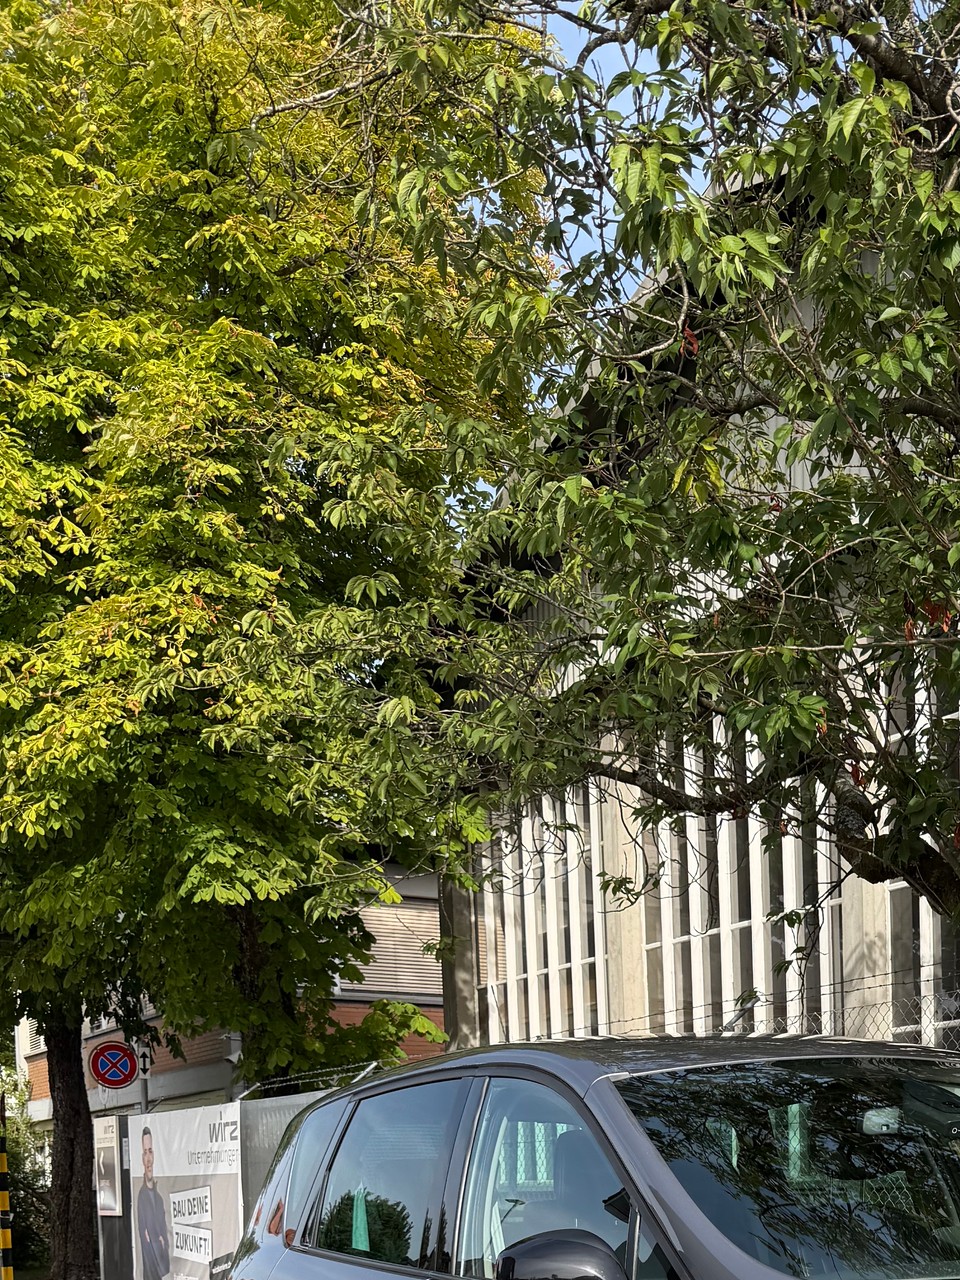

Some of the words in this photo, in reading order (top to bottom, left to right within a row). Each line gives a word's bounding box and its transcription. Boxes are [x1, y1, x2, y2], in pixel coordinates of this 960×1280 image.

[209, 1111, 239, 1143] wirz
[172, 1200, 186, 1218] BAU
[187, 1195, 209, 1216] DEINE
[175, 1231, 210, 1256] ZUKUNFT!
